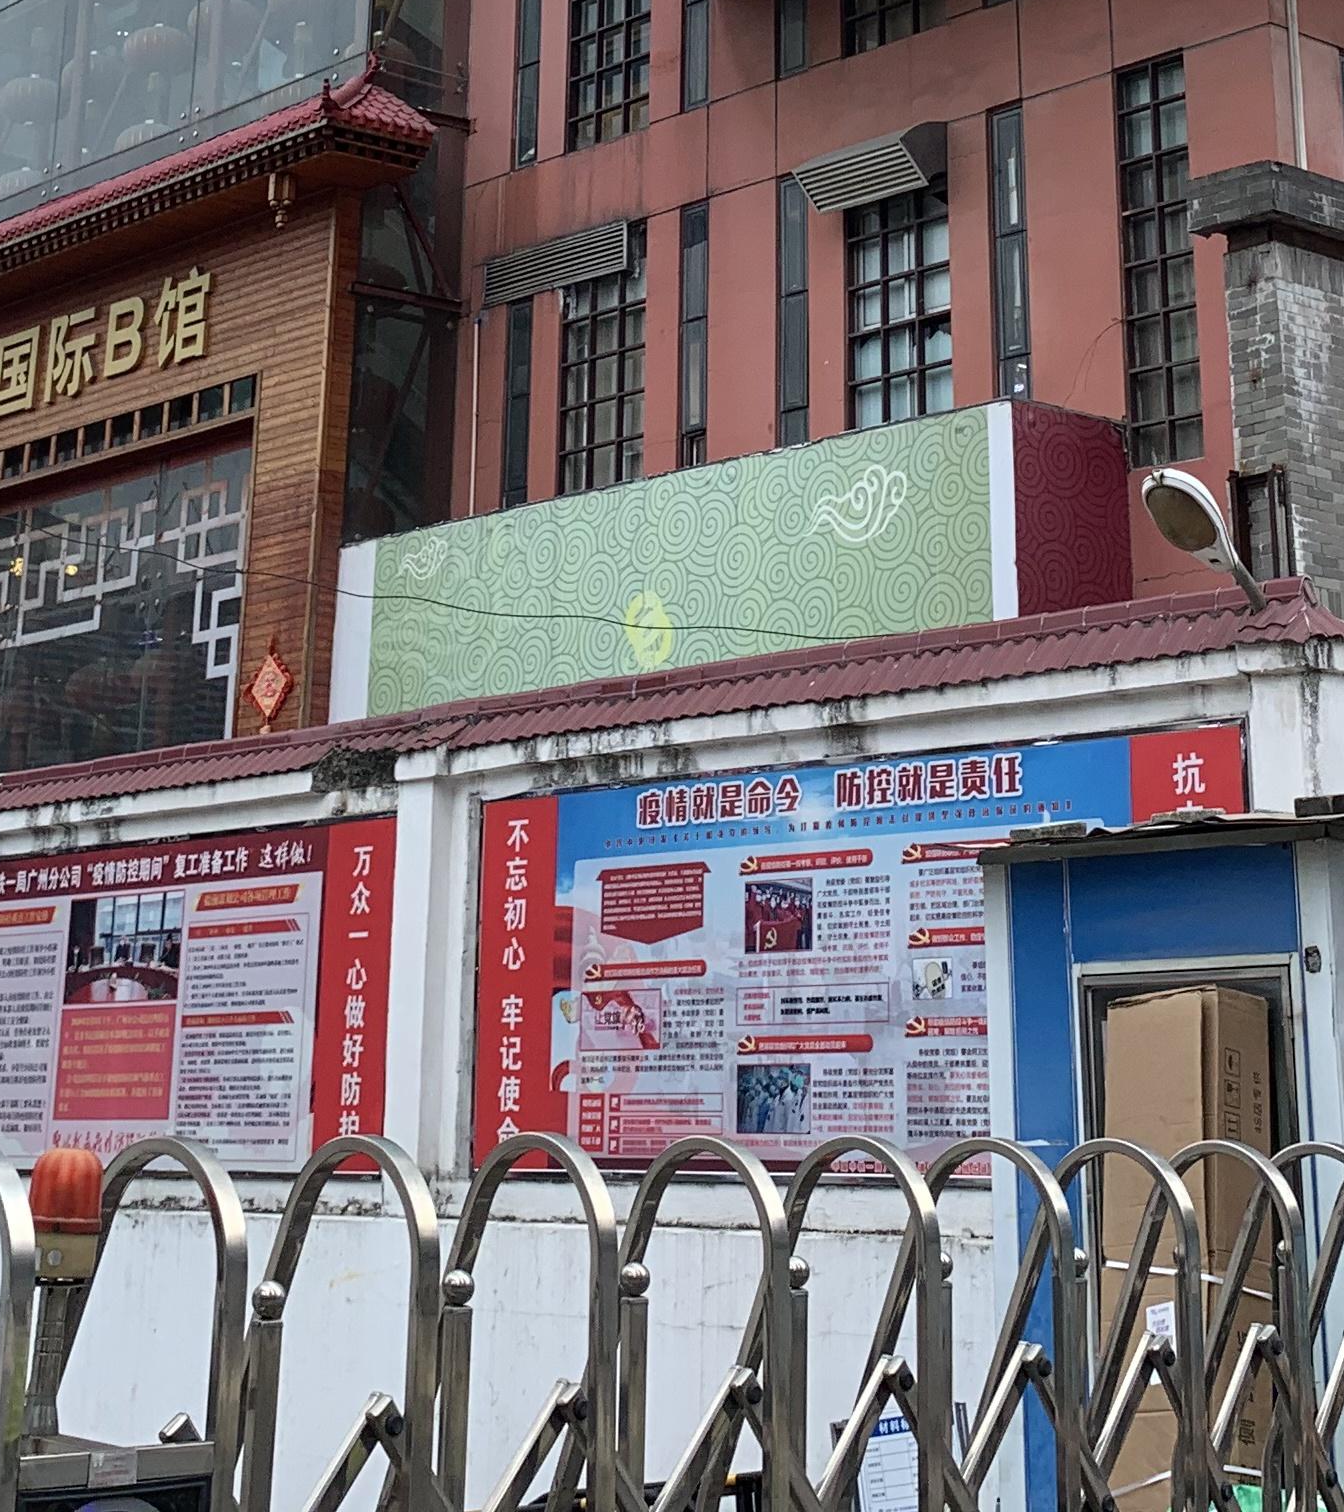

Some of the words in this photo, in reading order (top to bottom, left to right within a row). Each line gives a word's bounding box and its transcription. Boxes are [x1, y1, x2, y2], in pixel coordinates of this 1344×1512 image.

[636, 775, 802, 829] 疫情就是命令
[834, 752, 1024, 810] 防控就是责任
[504, 816, 532, 972] 不忘初心
[338, 845, 374, 1136] 万众一心做好防护
